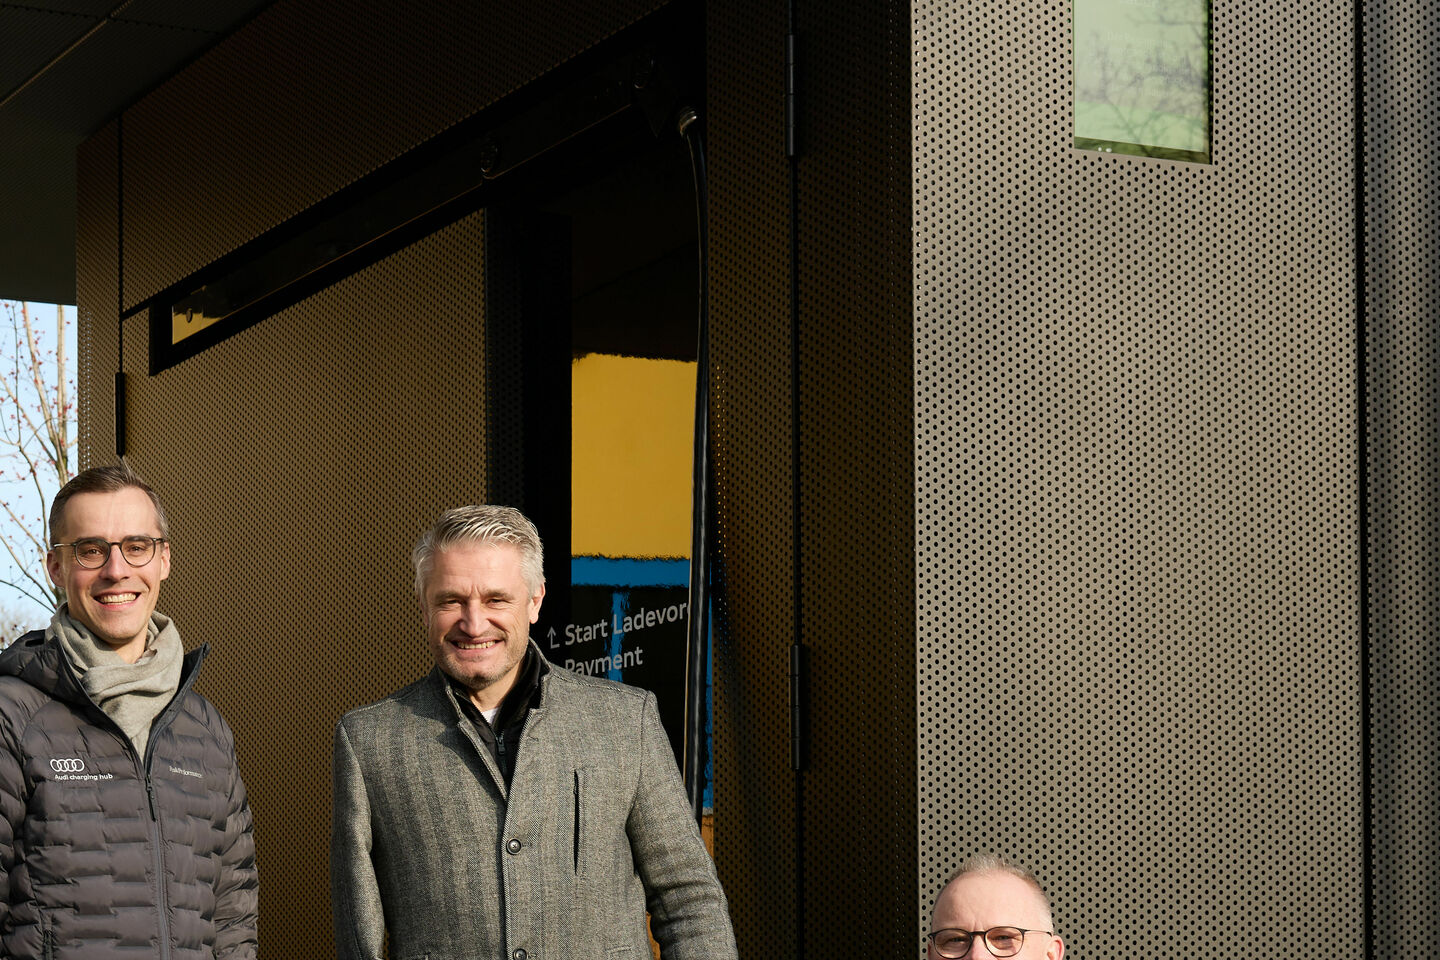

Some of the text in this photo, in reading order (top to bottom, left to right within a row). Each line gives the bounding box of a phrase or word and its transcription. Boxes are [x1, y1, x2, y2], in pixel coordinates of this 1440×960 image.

[565, 619, 608, 646] Start
[565, 646, 643, 676] Payment
[69, 773, 98, 781] charging
[98, 772, 114, 780] hub
